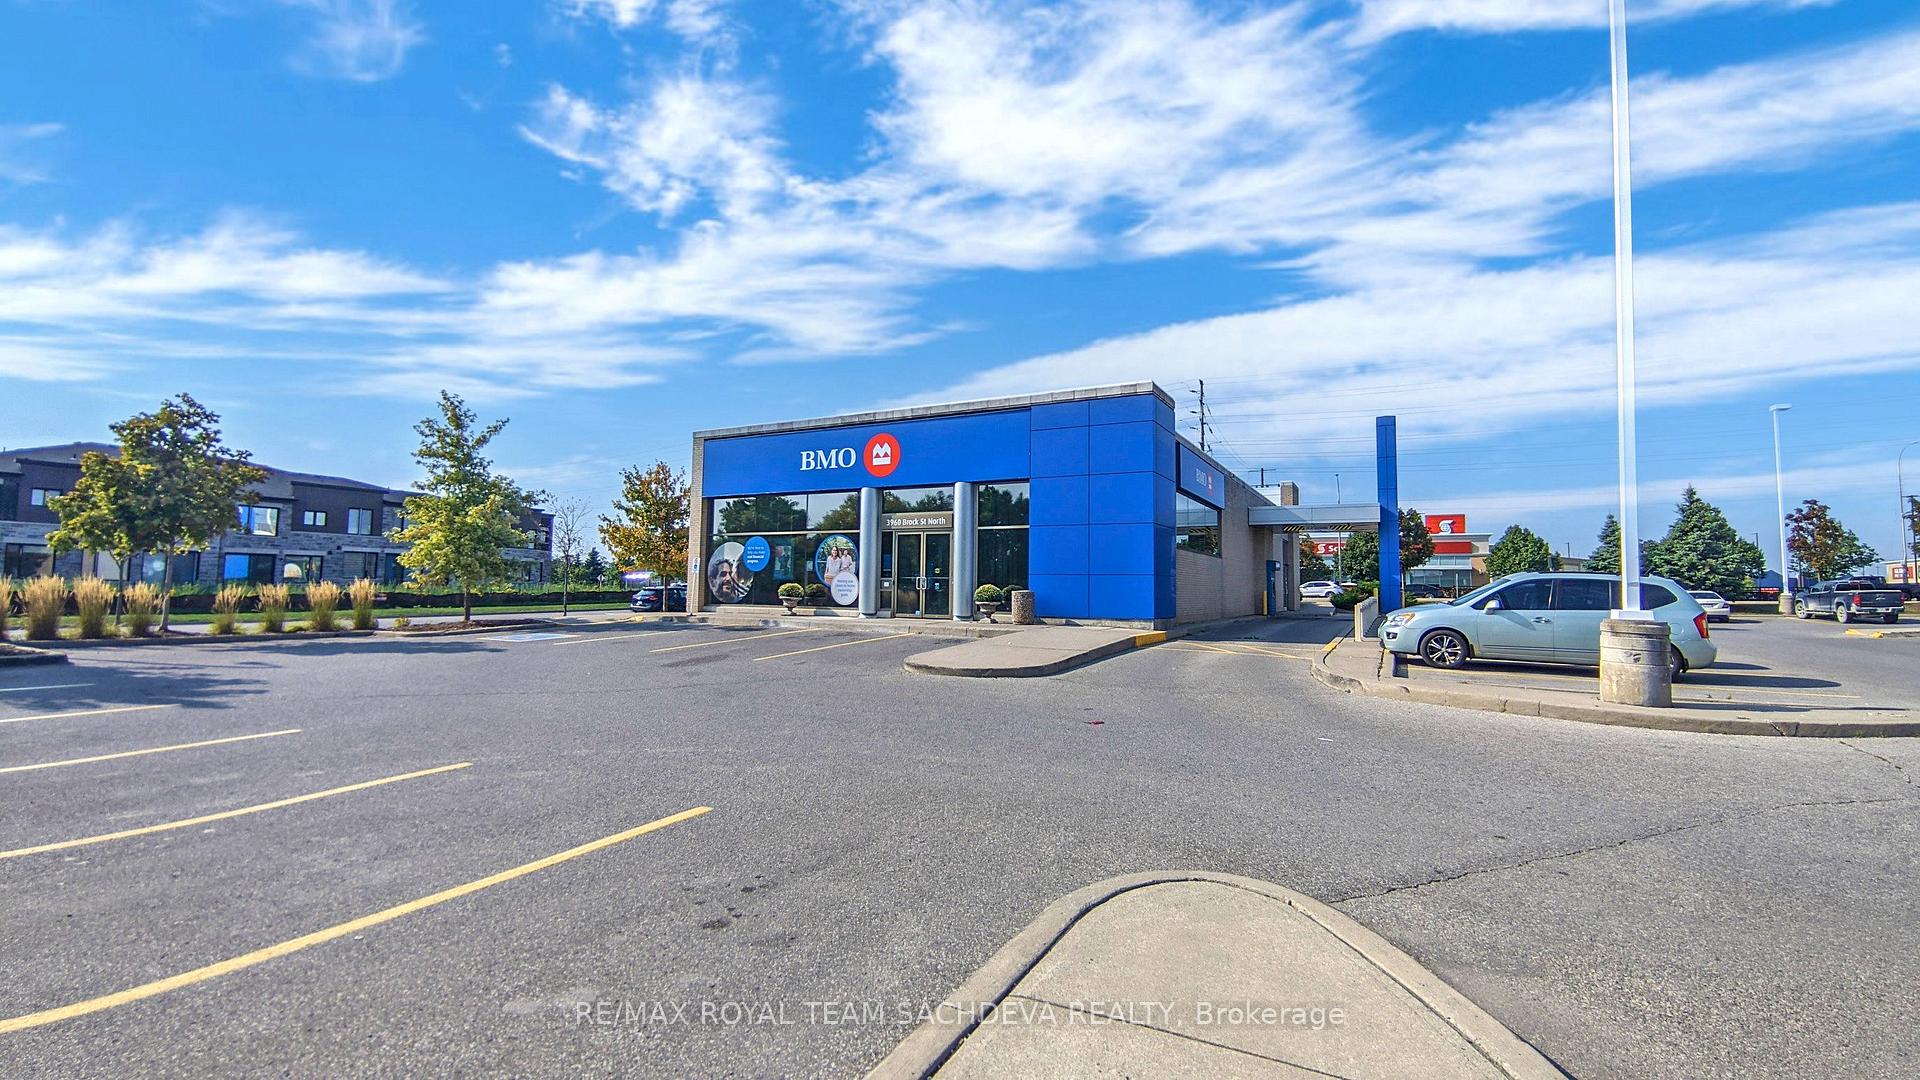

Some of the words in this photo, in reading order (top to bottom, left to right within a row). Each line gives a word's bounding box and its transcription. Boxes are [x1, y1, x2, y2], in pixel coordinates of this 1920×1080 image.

[800, 447, 857, 471] BMO
[886, 518, 901, 526] 3960
[902, 517, 919, 526] Brock
[920, 517, 927, 525] St
[928, 516, 946, 525] North
